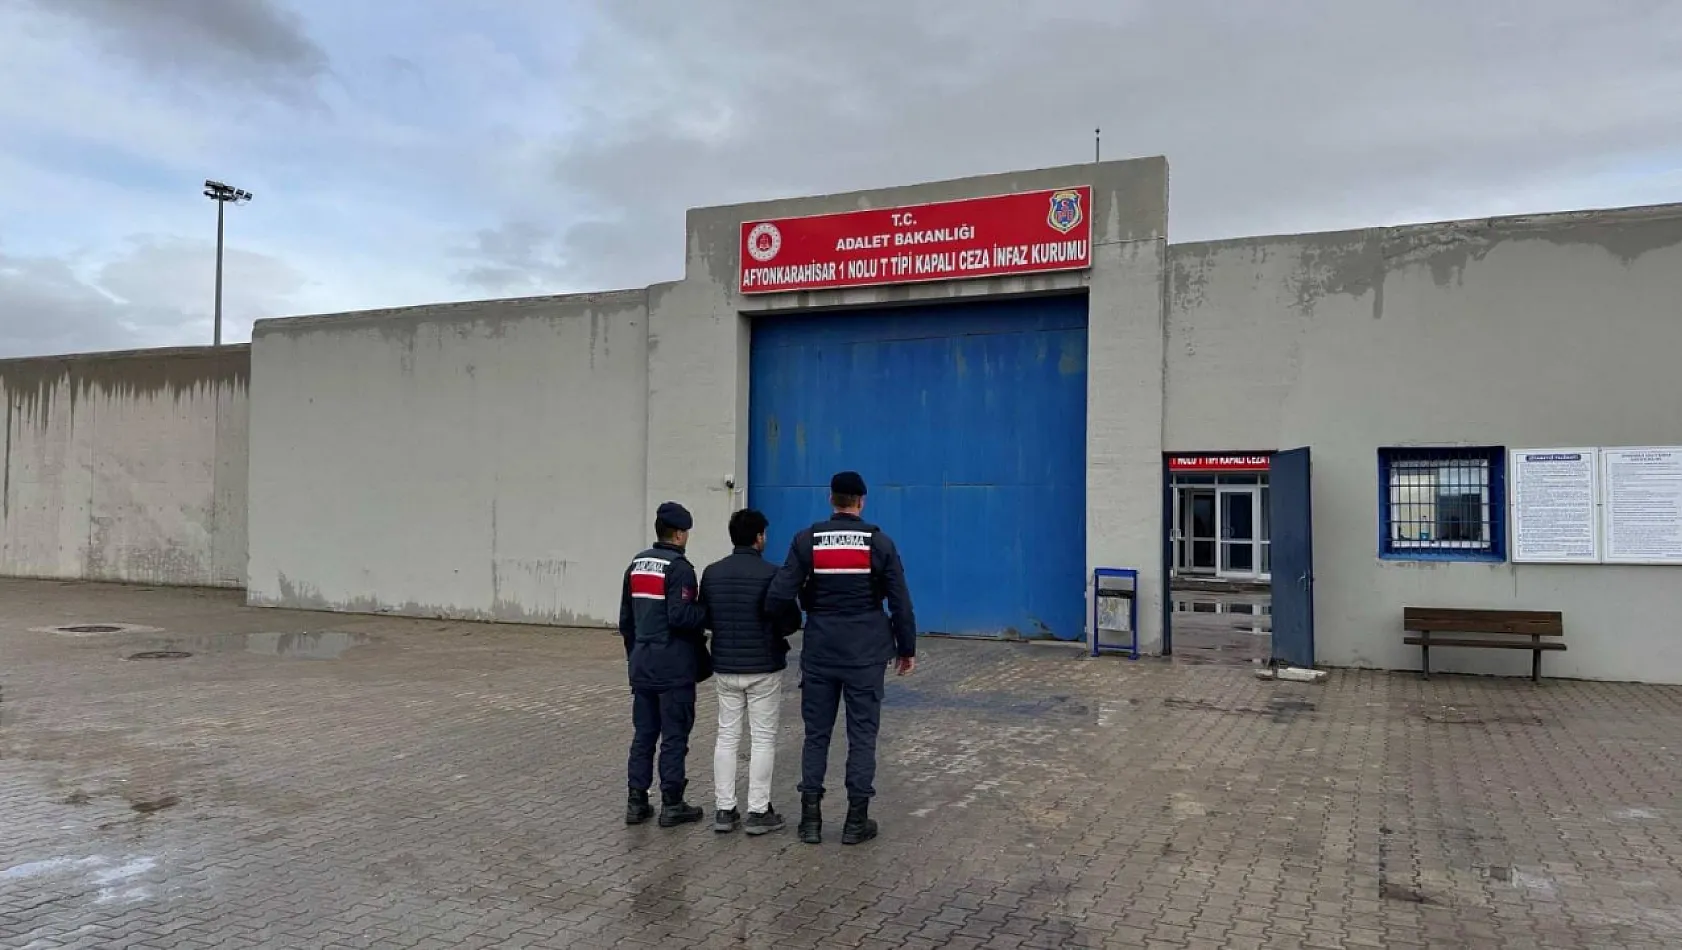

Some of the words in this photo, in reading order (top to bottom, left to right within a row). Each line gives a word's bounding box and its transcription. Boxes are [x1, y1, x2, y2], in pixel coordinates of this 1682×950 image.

[892, 213, 917, 227] T.C.
[836, 234, 891, 251] ADALET
[894, 223, 975, 246] BAKANLIĞI
[743, 259, 836, 286] AFYONKARAHİSAR
[838, 261, 845, 279] 1
[848, 258, 878, 279] NOLU
[881, 257, 889, 277] T
[890, 251, 913, 276] TİPİ
[915, 251, 956, 274] KAPALI
[959, 248, 990, 270] CEZA
[993, 242, 1029, 268] İNFAZ
[1031, 239, 1087, 264] KURUMU
